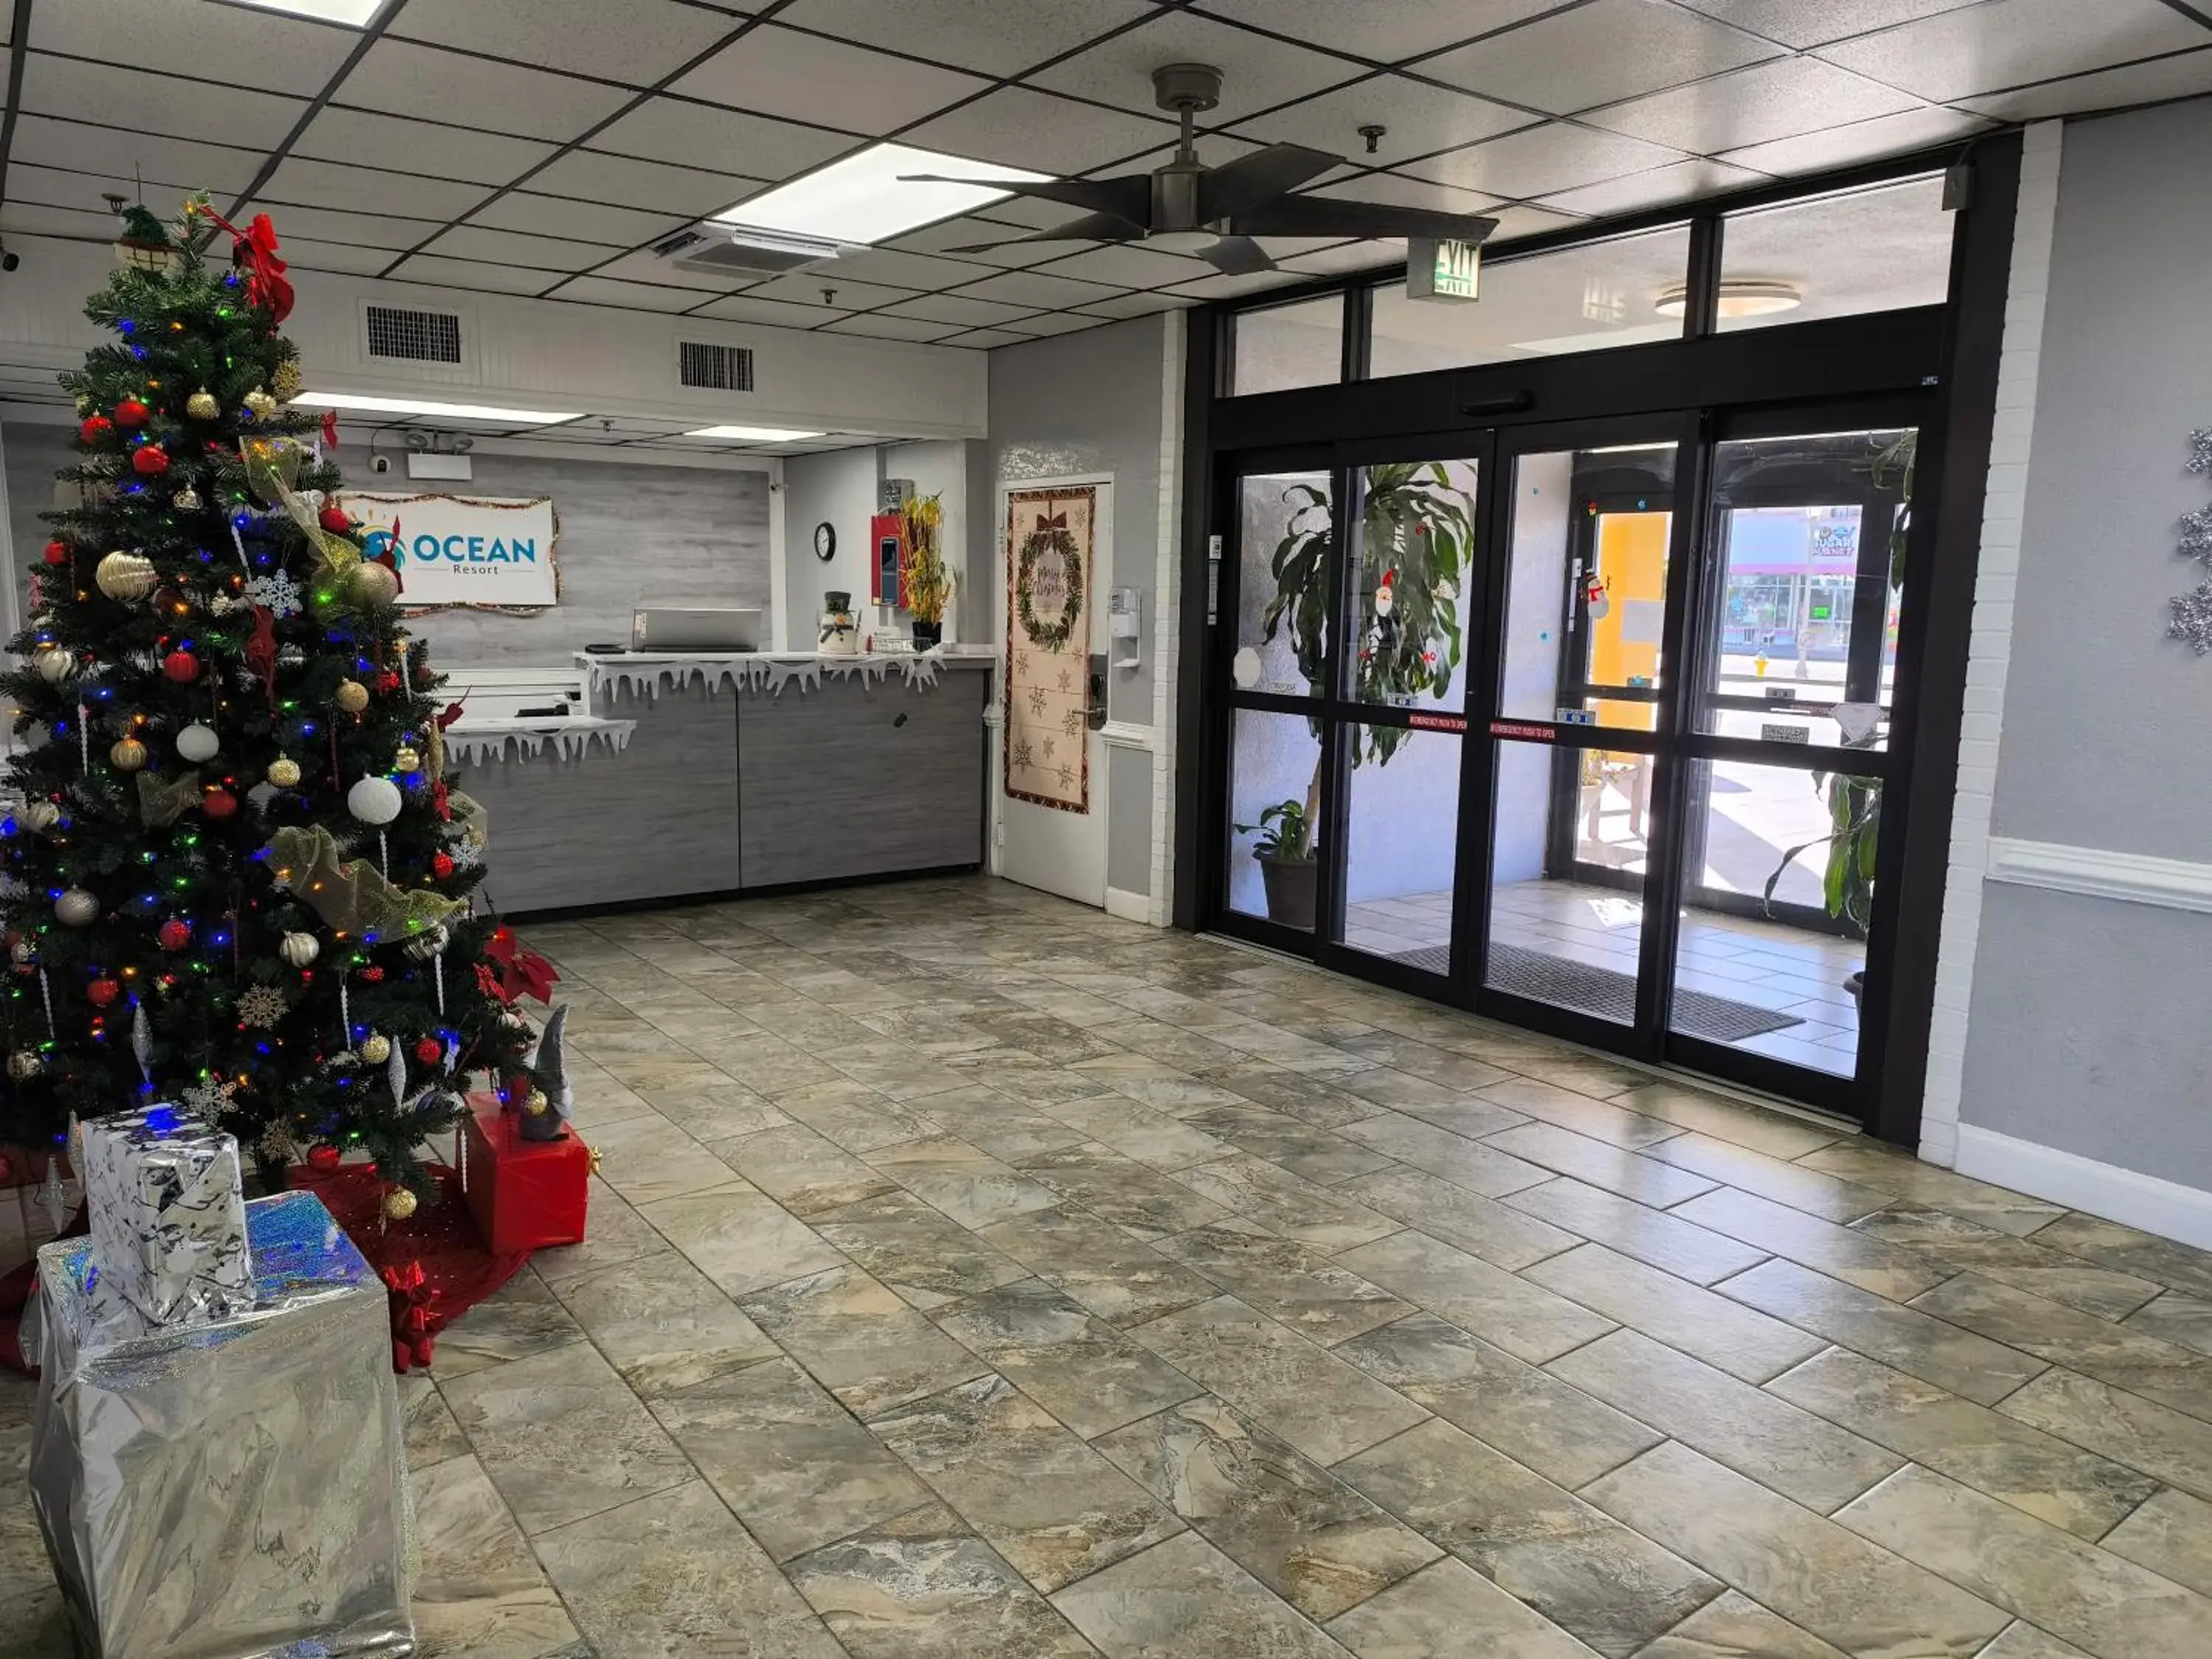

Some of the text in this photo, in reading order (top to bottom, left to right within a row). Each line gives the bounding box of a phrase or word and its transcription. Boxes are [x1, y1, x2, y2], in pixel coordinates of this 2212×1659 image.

[1435, 239, 1477, 295] EXIT
[414, 535, 535, 563] OCEAN
[453, 564, 498, 575] Resort
